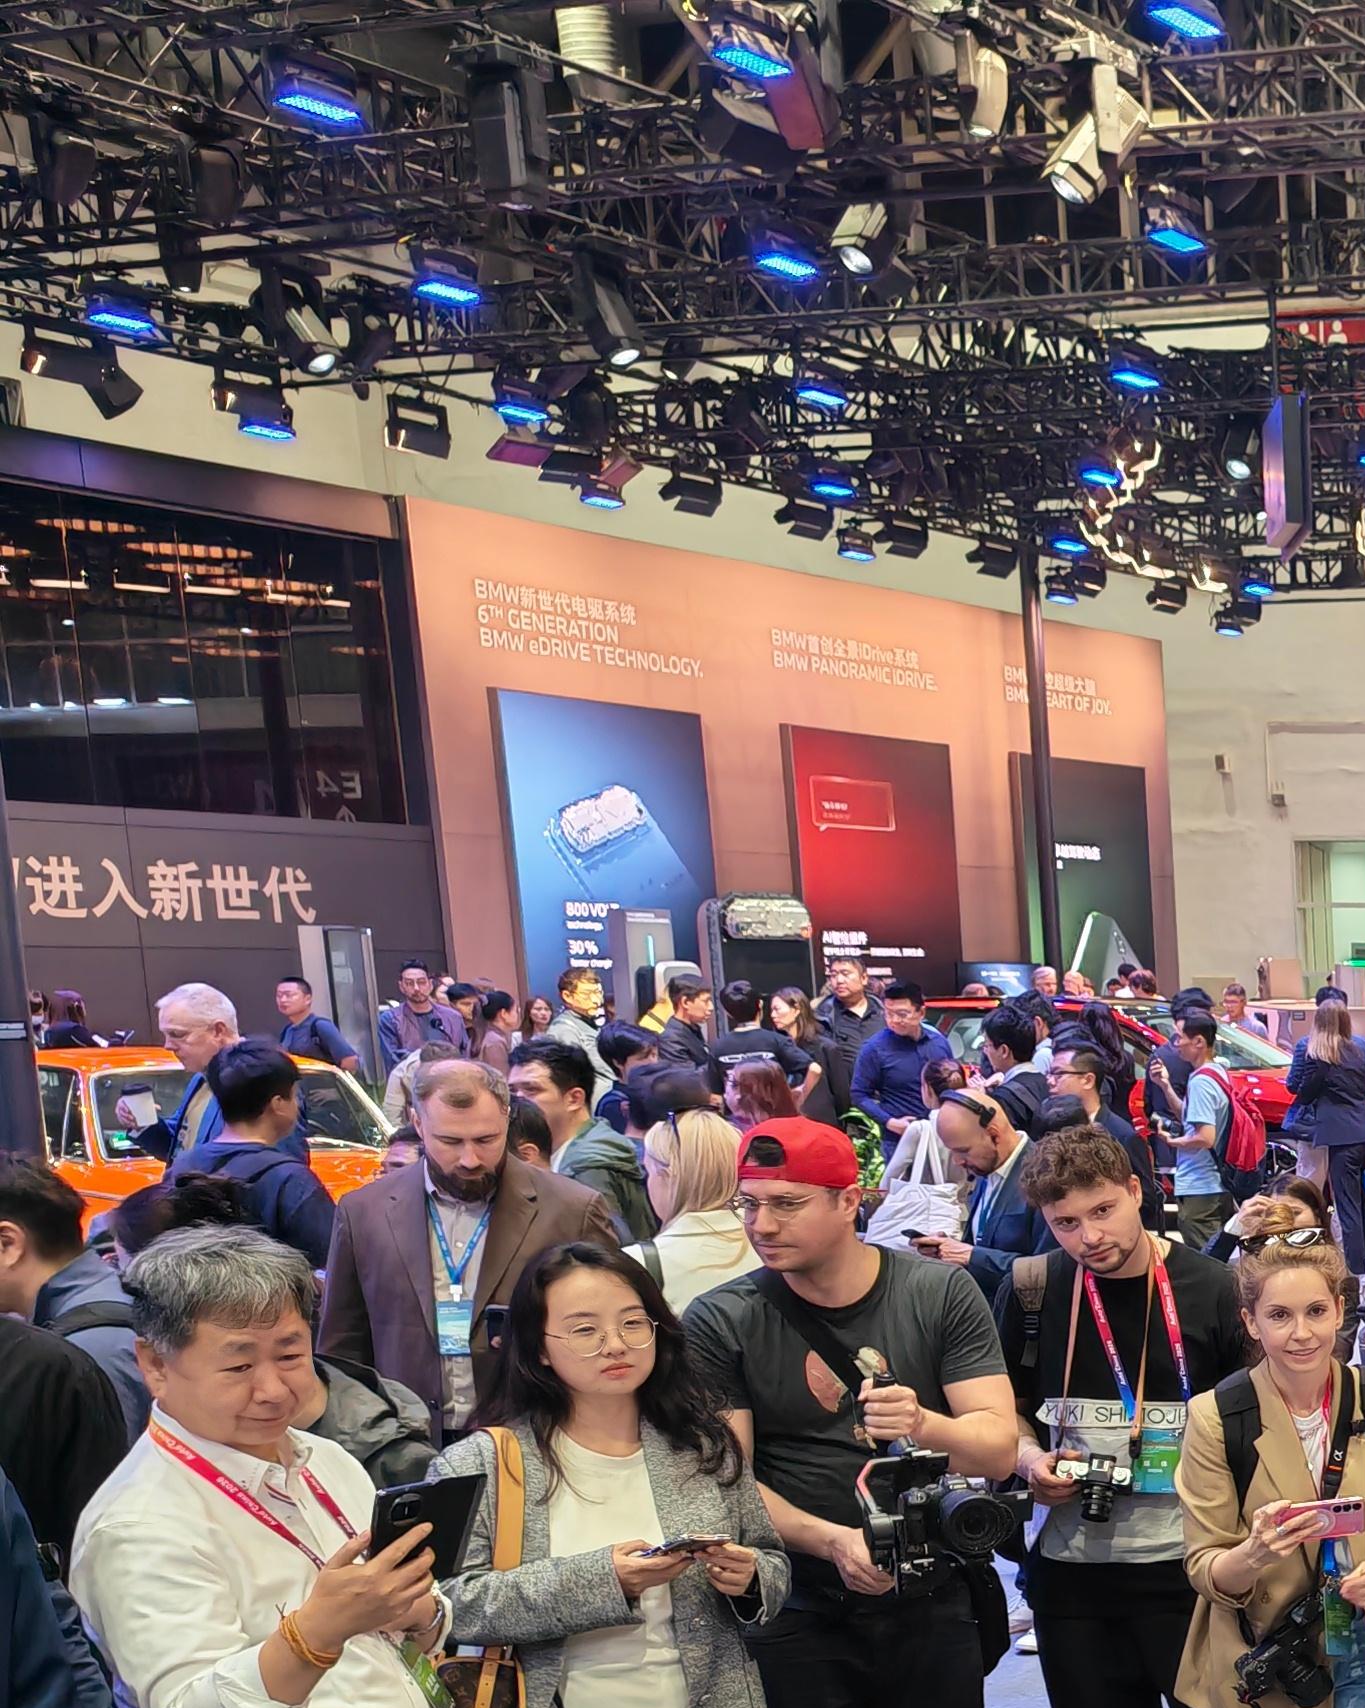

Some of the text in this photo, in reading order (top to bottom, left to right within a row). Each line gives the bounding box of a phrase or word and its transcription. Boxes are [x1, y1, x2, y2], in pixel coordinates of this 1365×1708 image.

[507, 608, 619, 644] GENERATION
[480, 627, 704, 678] BMW eDRIVE TECHNOLOGY.
[773, 650, 808, 672] BMW
[811, 656, 891, 685] PANORAMIC
[1047, 691, 1074, 711] EART
[1074, 696, 1091, 712] OF
[12, 855, 316, 924] 进入新世代
[1095, 1406, 1183, 1425] SHIOJI
[216, 1475, 279, 1526] Auto China 2026
